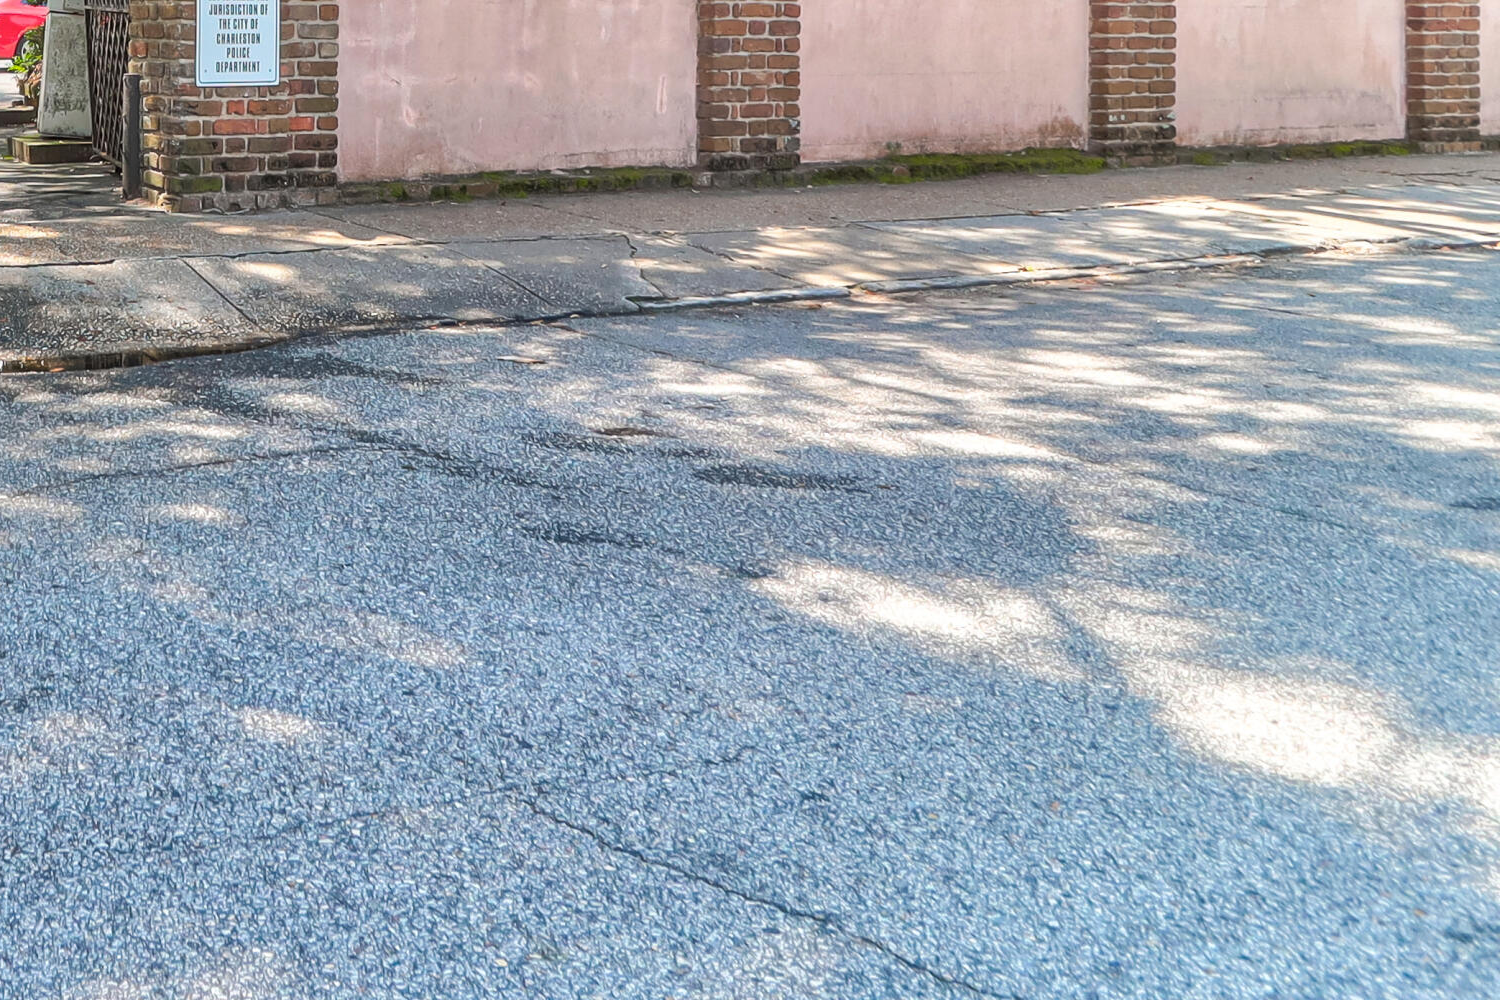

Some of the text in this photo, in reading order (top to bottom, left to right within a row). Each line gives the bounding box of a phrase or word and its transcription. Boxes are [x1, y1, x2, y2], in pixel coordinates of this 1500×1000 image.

[209, 4, 268, 15] JURISDICTION OF
[219, 18, 259, 30] THE CITY OF
[216, 33, 261, 44] CHARLESTON
[226, 47, 250, 59] POLICE
[215, 61, 260, 73] DEPARTMENT
